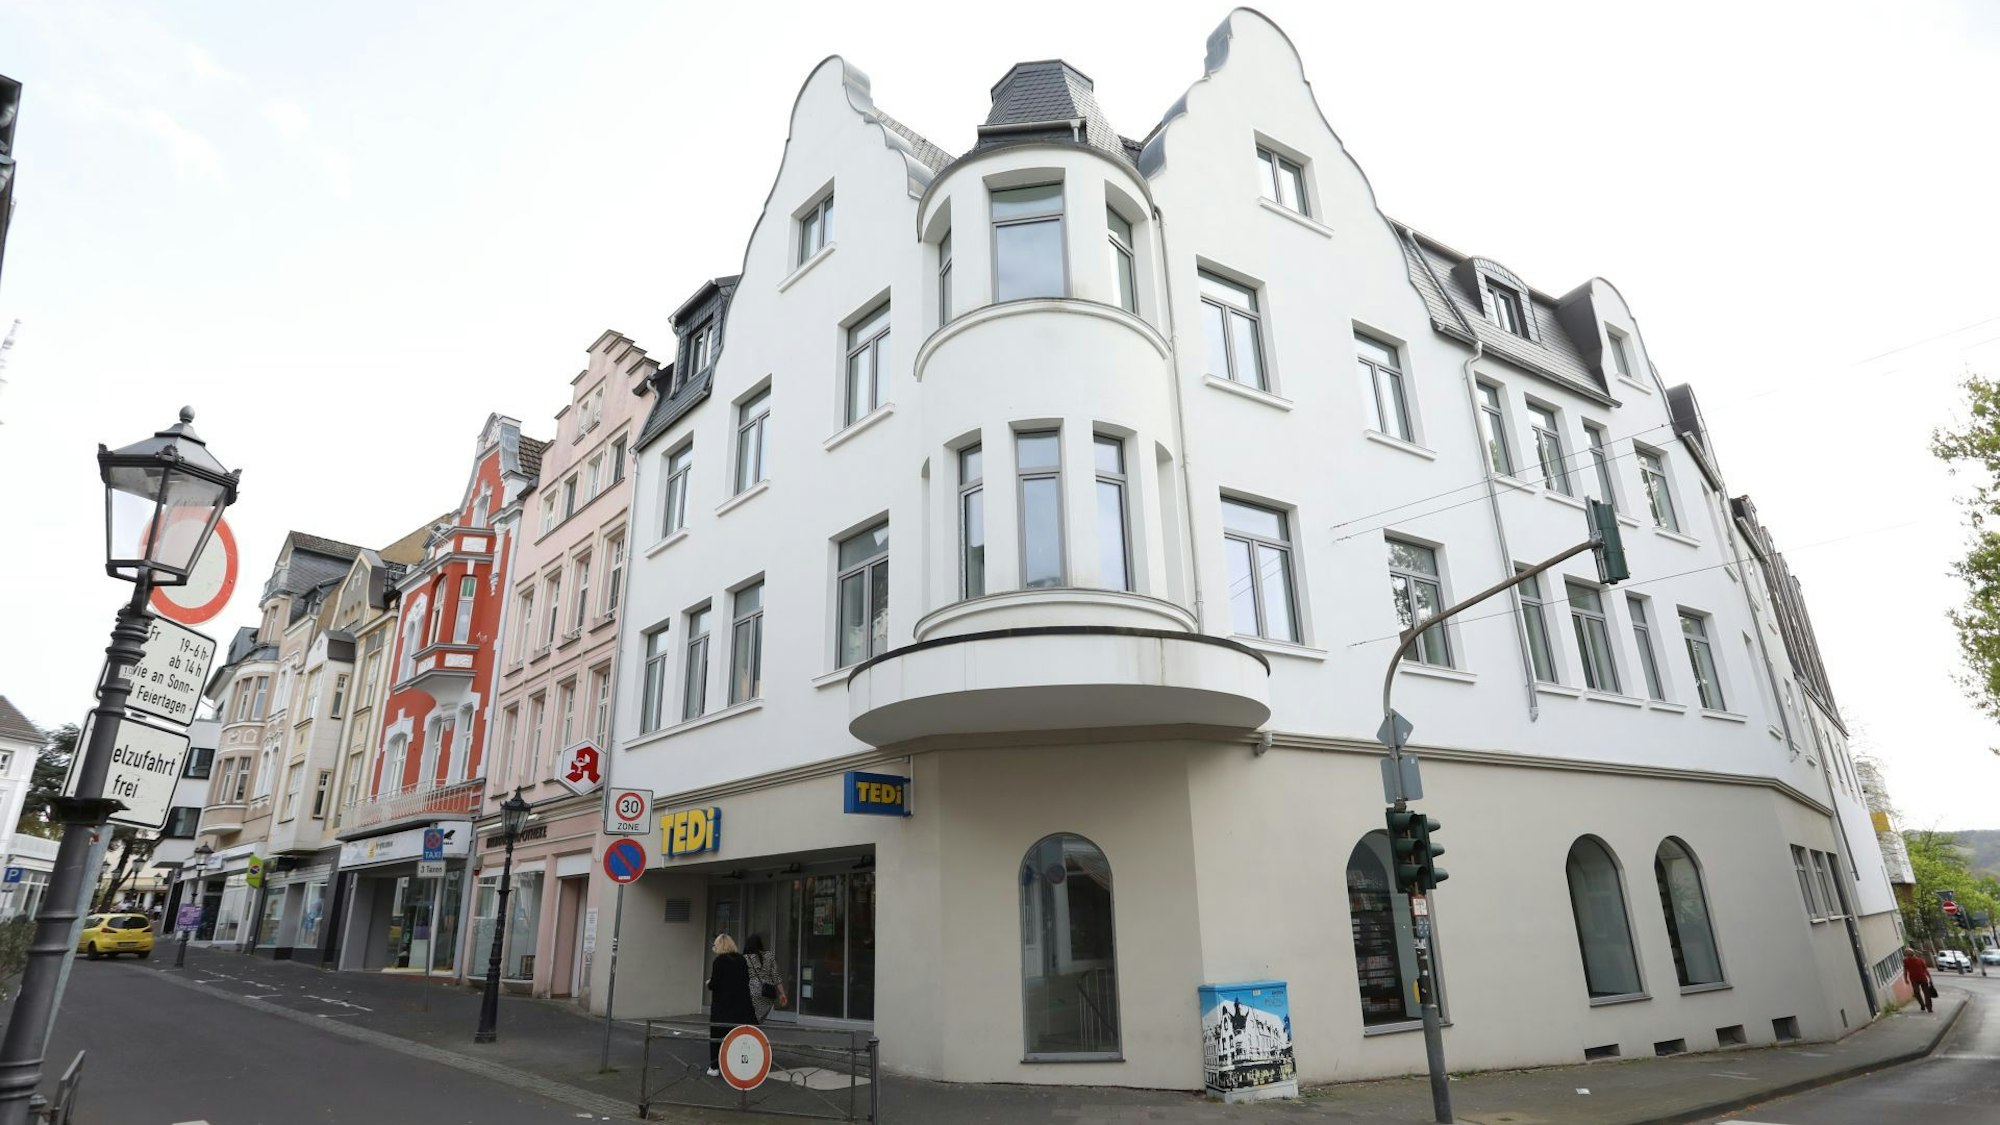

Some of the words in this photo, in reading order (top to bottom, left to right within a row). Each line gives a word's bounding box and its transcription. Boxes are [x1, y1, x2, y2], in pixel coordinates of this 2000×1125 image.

[169, 655, 181, 669] ab
[151, 671, 164, 684] an
[168, 673, 194, 694] Sonn-
[136, 685, 187, 714] Feiertagen
[112, 744, 176, 776] elzufahrt
[112, 774, 140, 798] frei
[856, 781, 902, 805] TEDi
[621, 799, 639, 814] 30
[617, 822, 640, 831] ZONE
[659, 807, 716, 856] TEDi
[425, 851, 441, 859] TAXI
[7, 868, 20, 880] P
